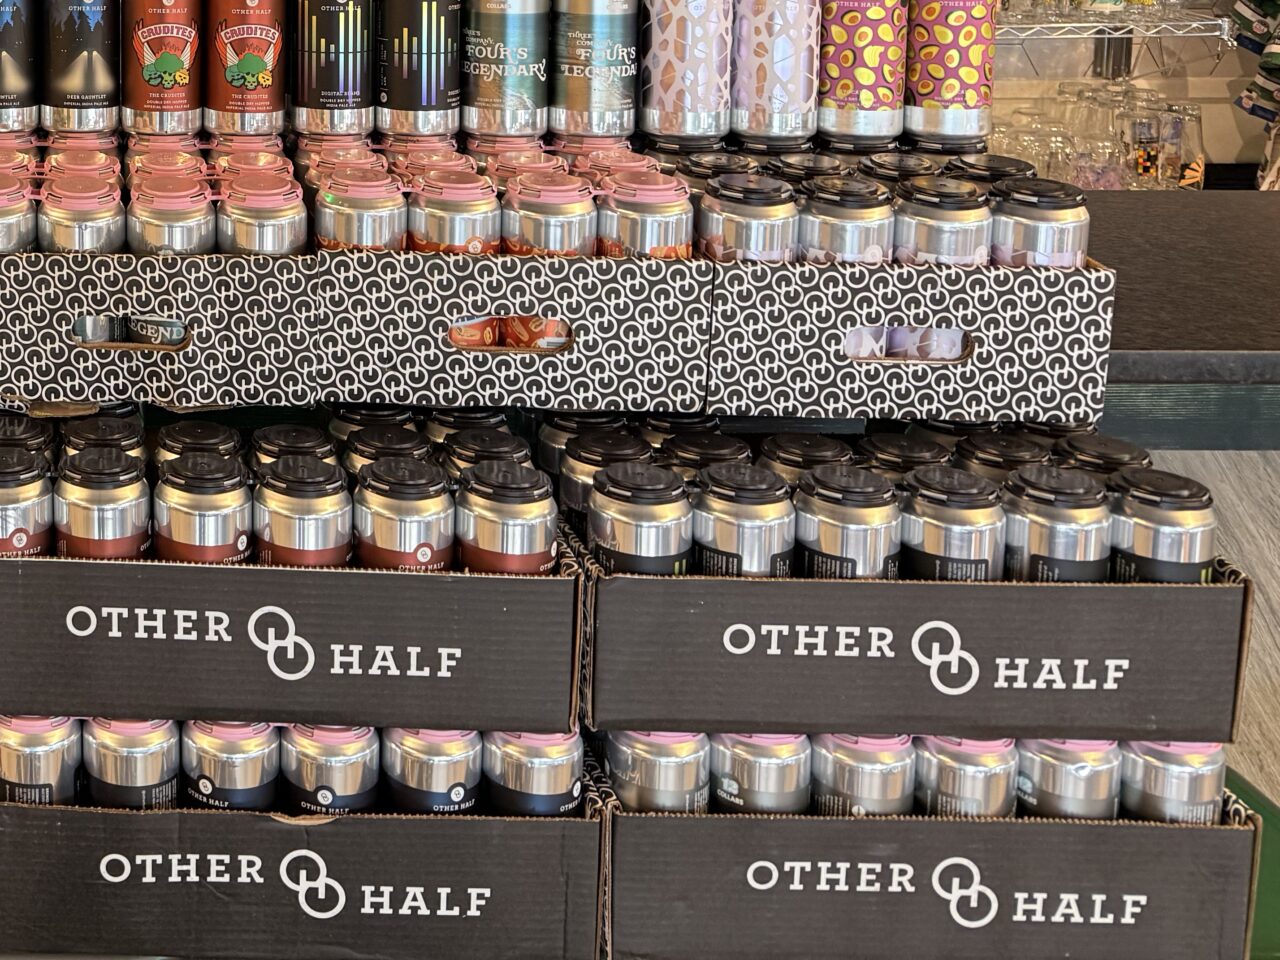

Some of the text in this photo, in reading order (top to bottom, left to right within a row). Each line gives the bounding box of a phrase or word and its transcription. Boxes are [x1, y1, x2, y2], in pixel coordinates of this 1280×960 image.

[140, 25, 193, 40] CRUDITES
[224, 26, 276, 41] CRUDITES
[466, 43, 528, 64] FOUR'S
[576, 44, 636, 65] FOUR'S
[464, 58, 546, 82] EGENDARY
[24, 546, 41, 556] HALF
[224, 554, 243, 564] OTHER
[428, 562, 444, 570] HALF
[66, 606, 463, 678] OTHER HALF
[722, 624, 1130, 690] OTHER HALF
[188, 787, 229, 807] OTHER HALF
[461, 799, 475, 809] HALF
[717, 789, 744, 806] COLLABS
[301, 802, 325, 813] OTHER
[99, 853, 492, 917] OTHER HALF
[746, 860, 1148, 924] OTHER HALF
